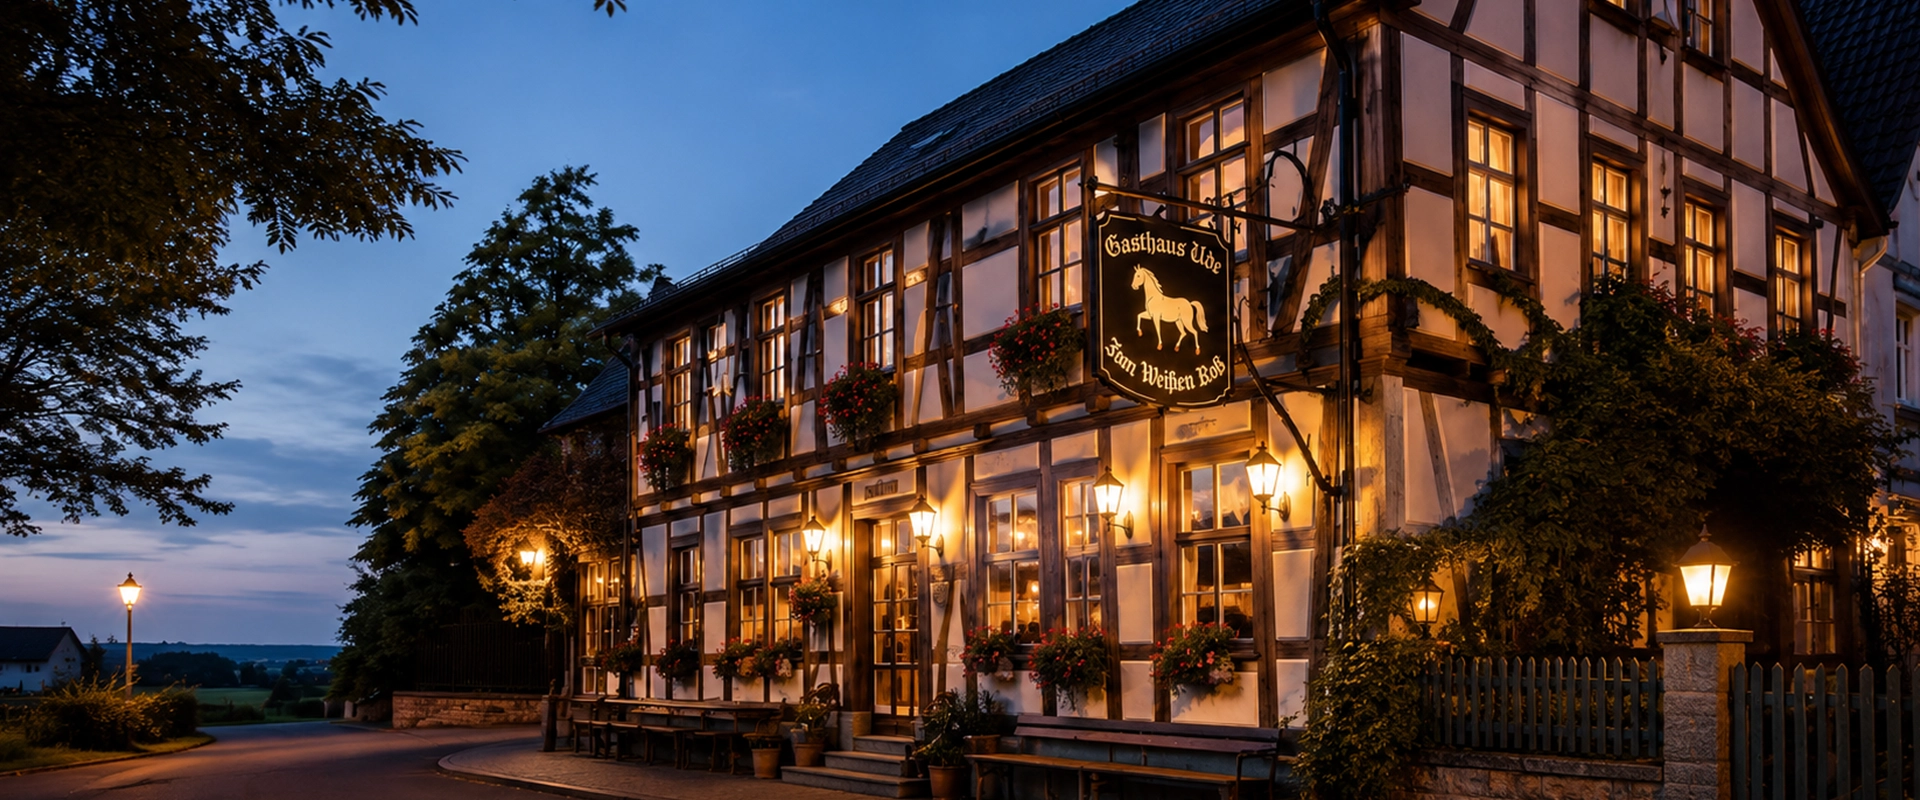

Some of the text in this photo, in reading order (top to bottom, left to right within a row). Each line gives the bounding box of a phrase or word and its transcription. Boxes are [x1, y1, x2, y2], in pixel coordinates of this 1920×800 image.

[1105, 231, 1222, 275] Gasthaus Ude
[1140, 360, 1196, 395] Weißen
